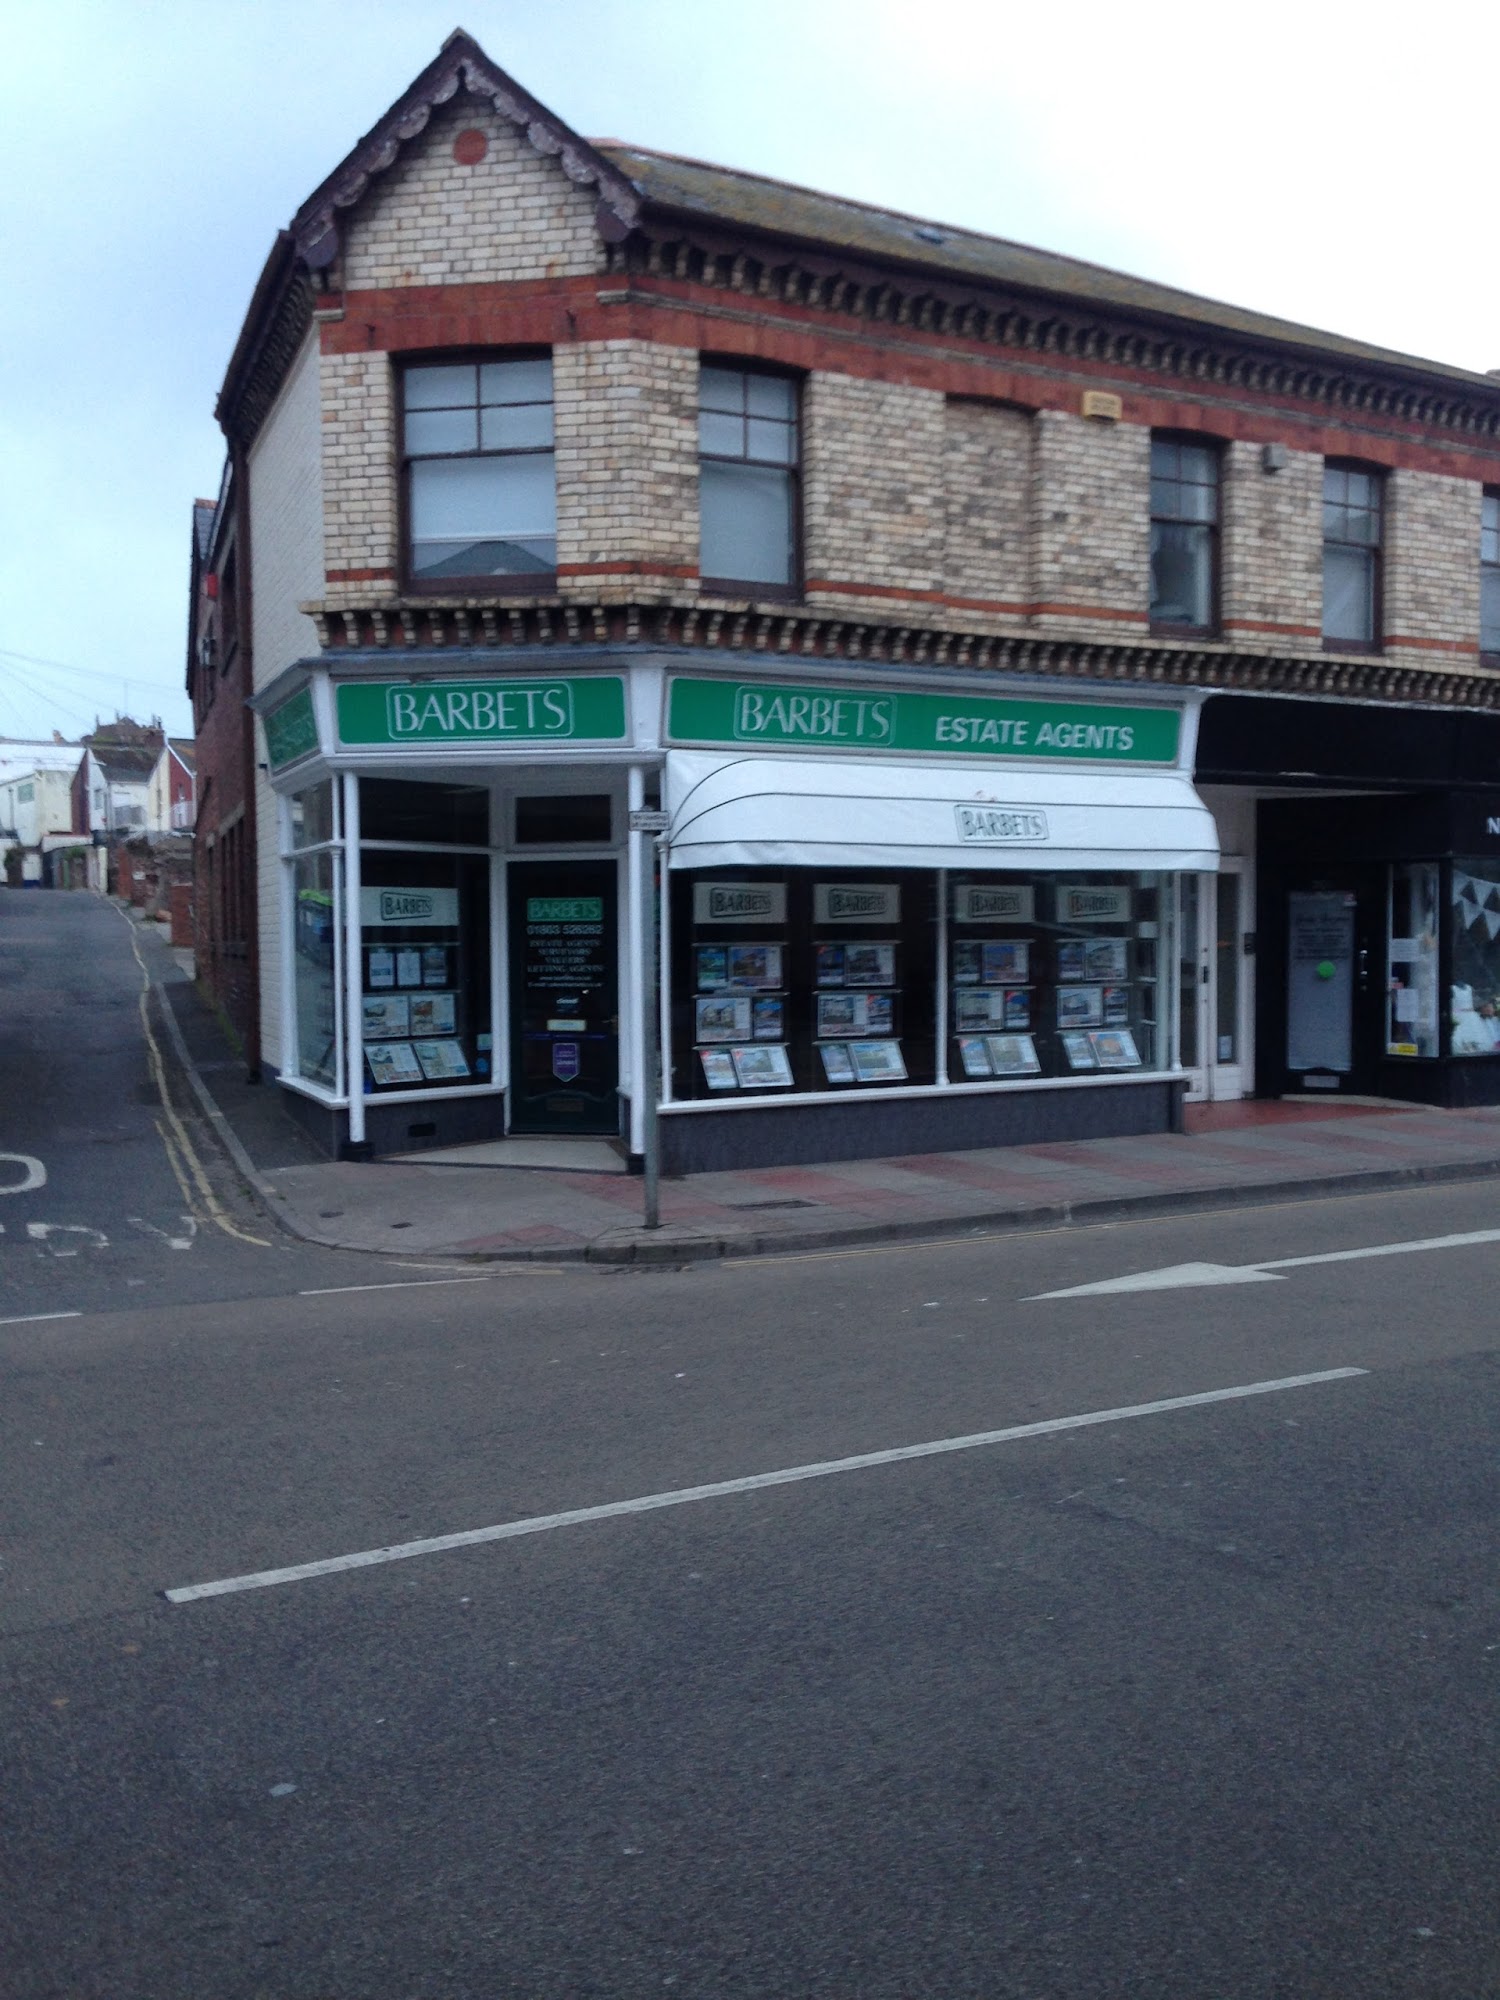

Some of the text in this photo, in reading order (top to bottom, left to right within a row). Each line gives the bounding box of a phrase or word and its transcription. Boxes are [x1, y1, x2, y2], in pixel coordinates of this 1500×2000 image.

[393, 689, 567, 732] BARBETS
[739, 693, 891, 739] BARBETS
[935, 716, 1135, 751] ESTATE AGENTS
[961, 810, 1043, 836] BARBETS
[384, 897, 433, 915] BARBETS
[530, 901, 599, 918] BARBETS
[714, 892, 772, 912] BARBETS
[833, 893, 886, 912] BARBETS
